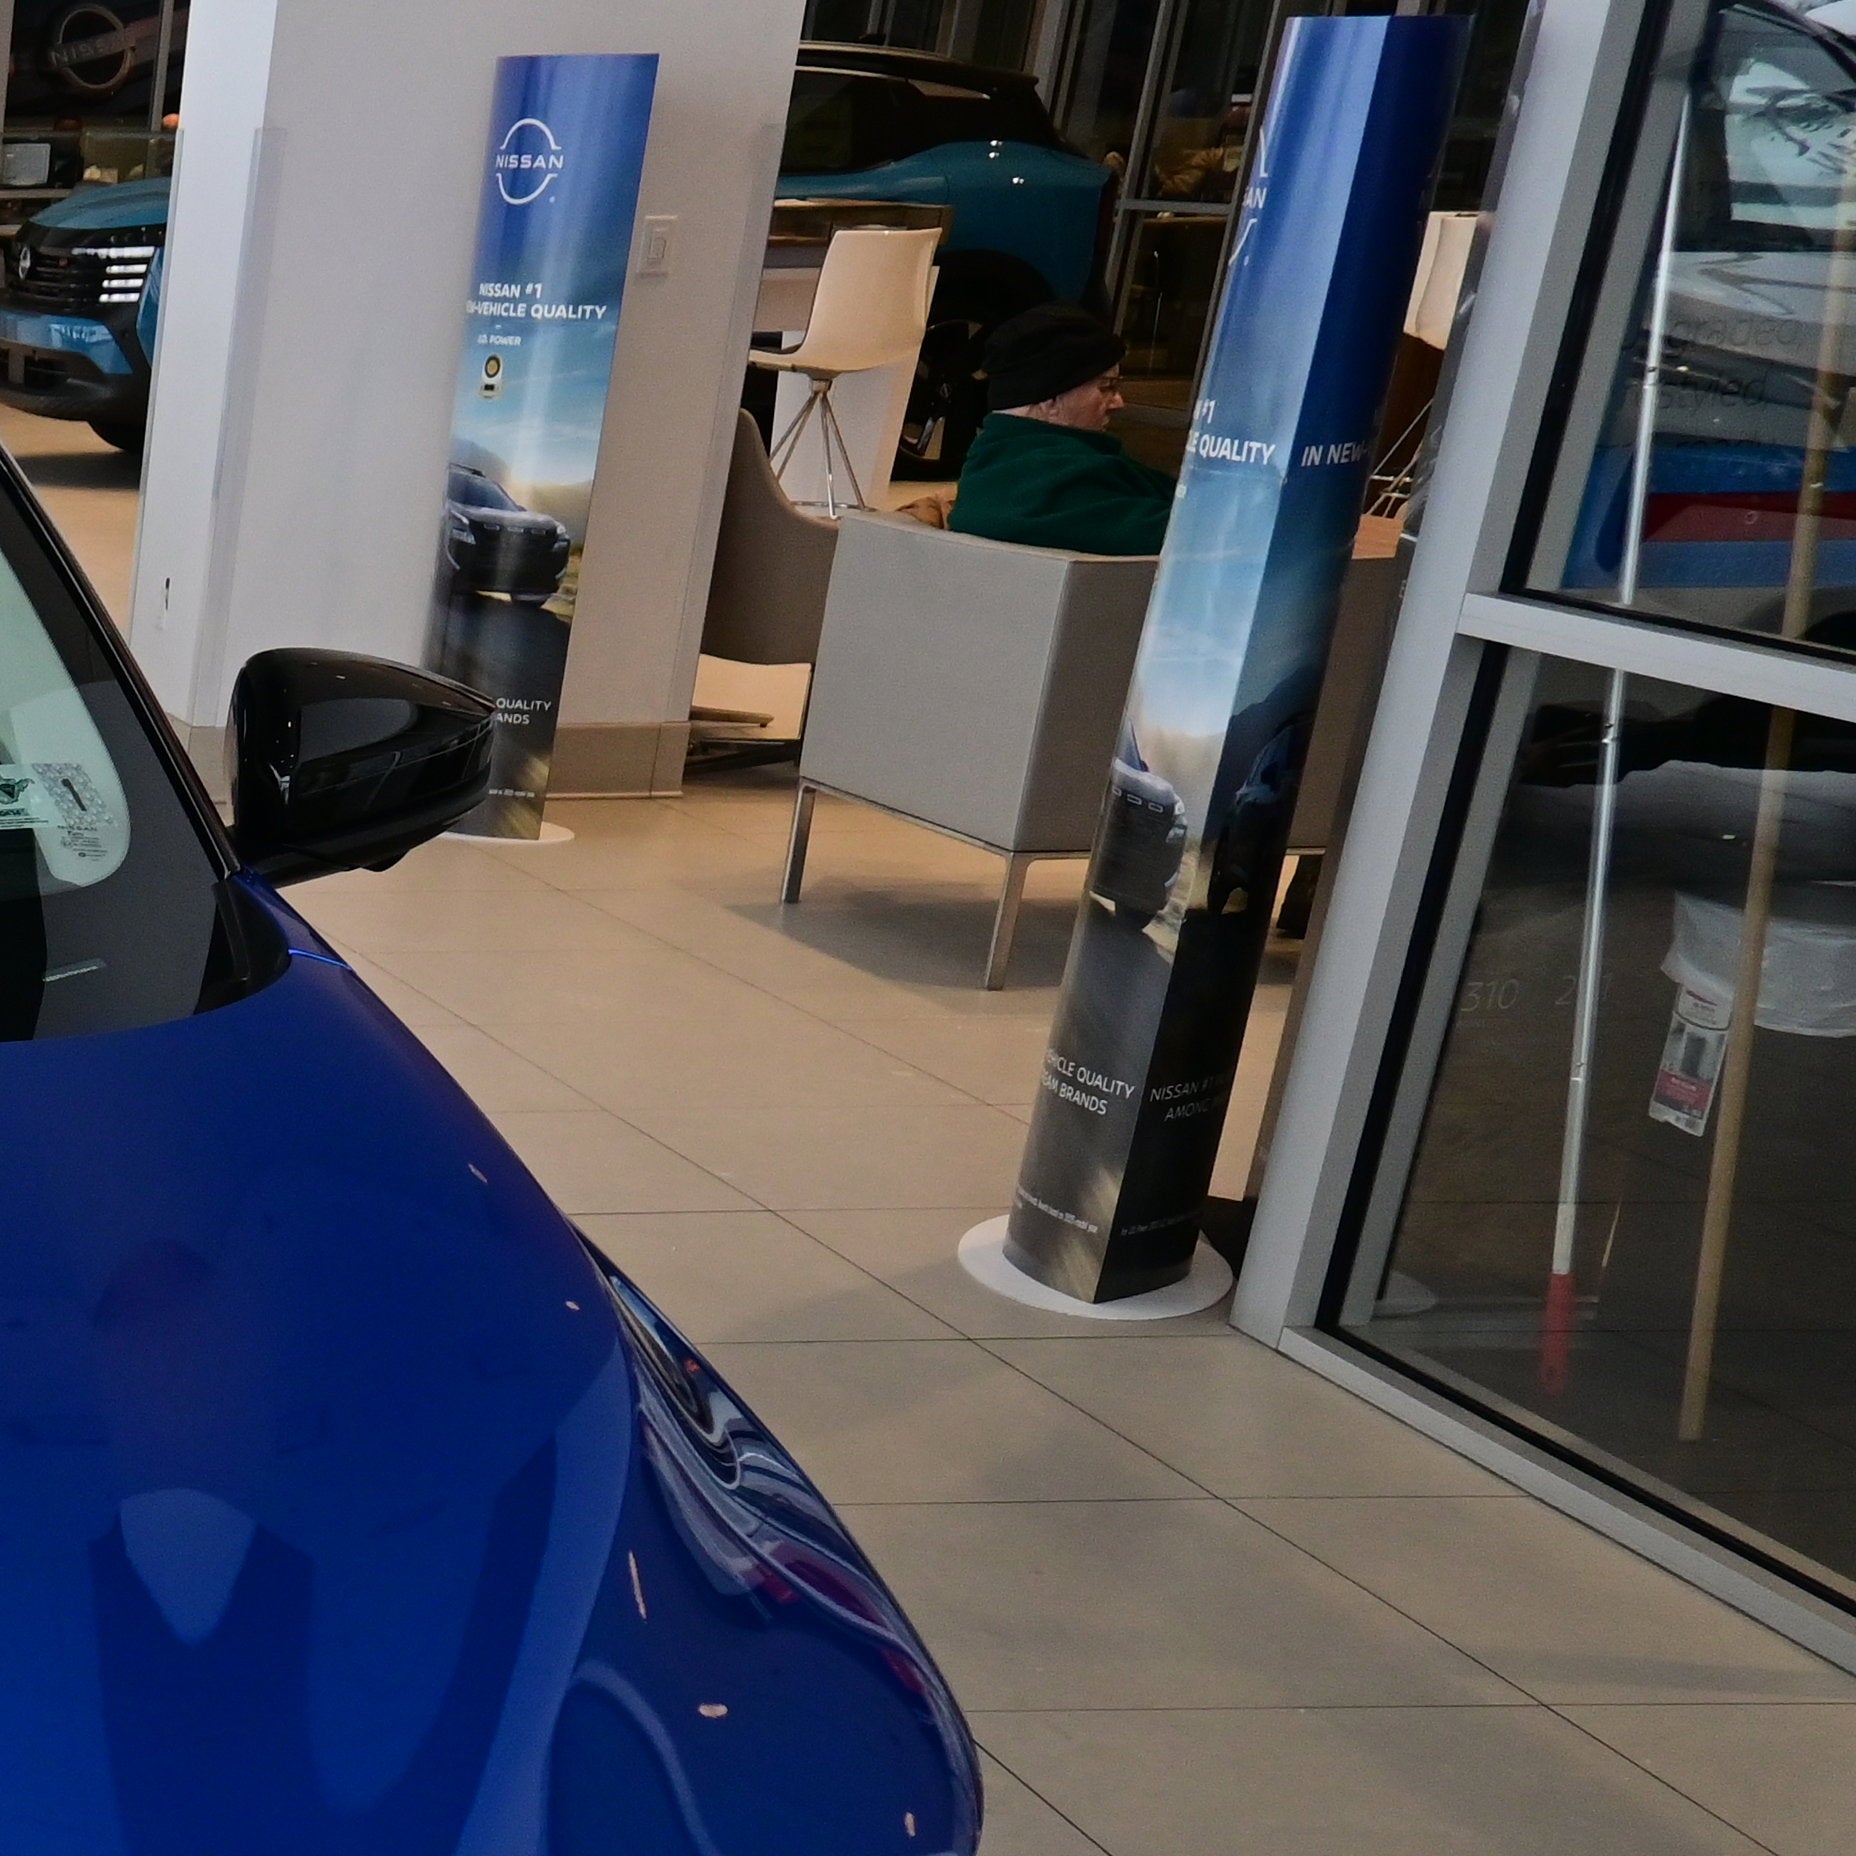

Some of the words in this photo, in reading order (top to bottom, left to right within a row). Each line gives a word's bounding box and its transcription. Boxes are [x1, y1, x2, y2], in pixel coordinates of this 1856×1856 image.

[495, 153, 564, 169] NISSAN
[479, 282, 521, 299] NISSAN
[525, 282, 543, 299] #1
[531, 303, 607, 320] QUALITY
[1199, 434, 1276, 465] QUALITY
[1300, 445, 1323, 467] IN
[496, 697, 552, 711] QUALITY
[496, 713, 530, 725] ANDS
[1460, 977, 1520, 1012] 310
[1076, 1066, 1136, 1099] QUALITY
[1149, 1079, 1199, 1103] NISSAN
[1059, 1082, 1108, 1116] BRANDS
